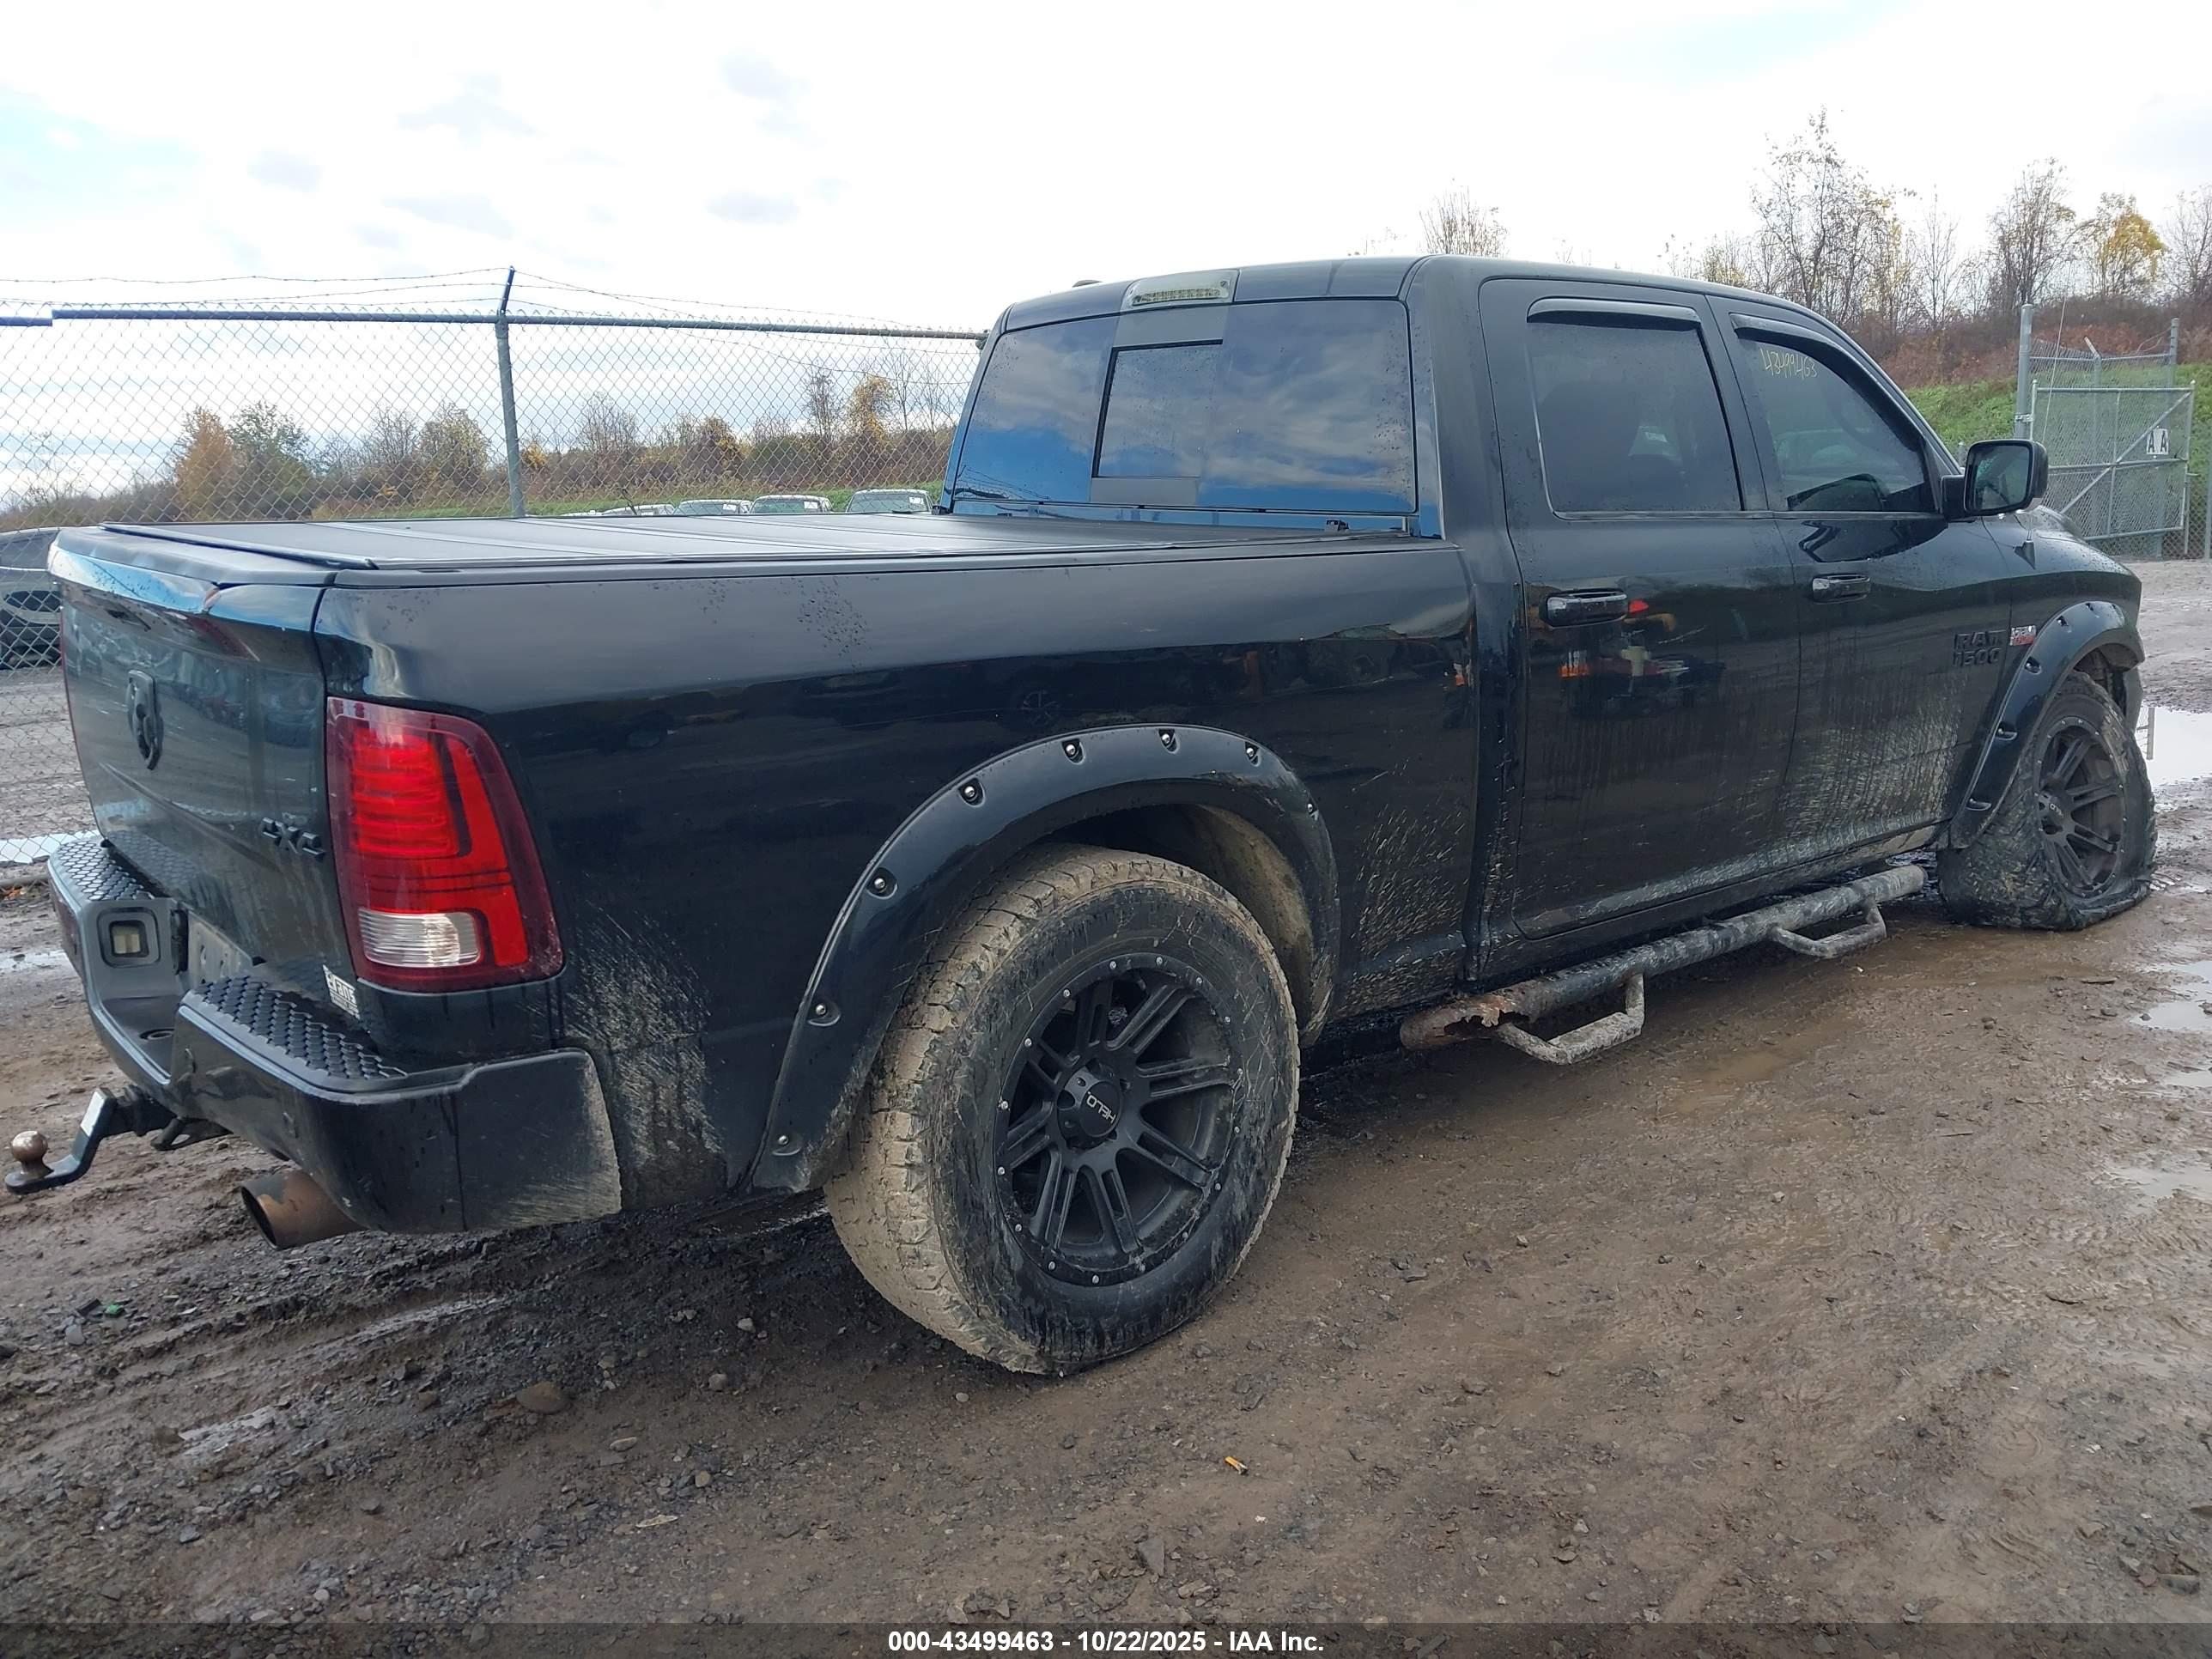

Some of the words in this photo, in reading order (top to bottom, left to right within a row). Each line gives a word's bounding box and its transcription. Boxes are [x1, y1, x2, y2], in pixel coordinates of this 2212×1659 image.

[1954, 629, 2007, 649] RAM
[1953, 647, 2002, 666] 1500
[1086, 1095, 1116, 1124] HELO
